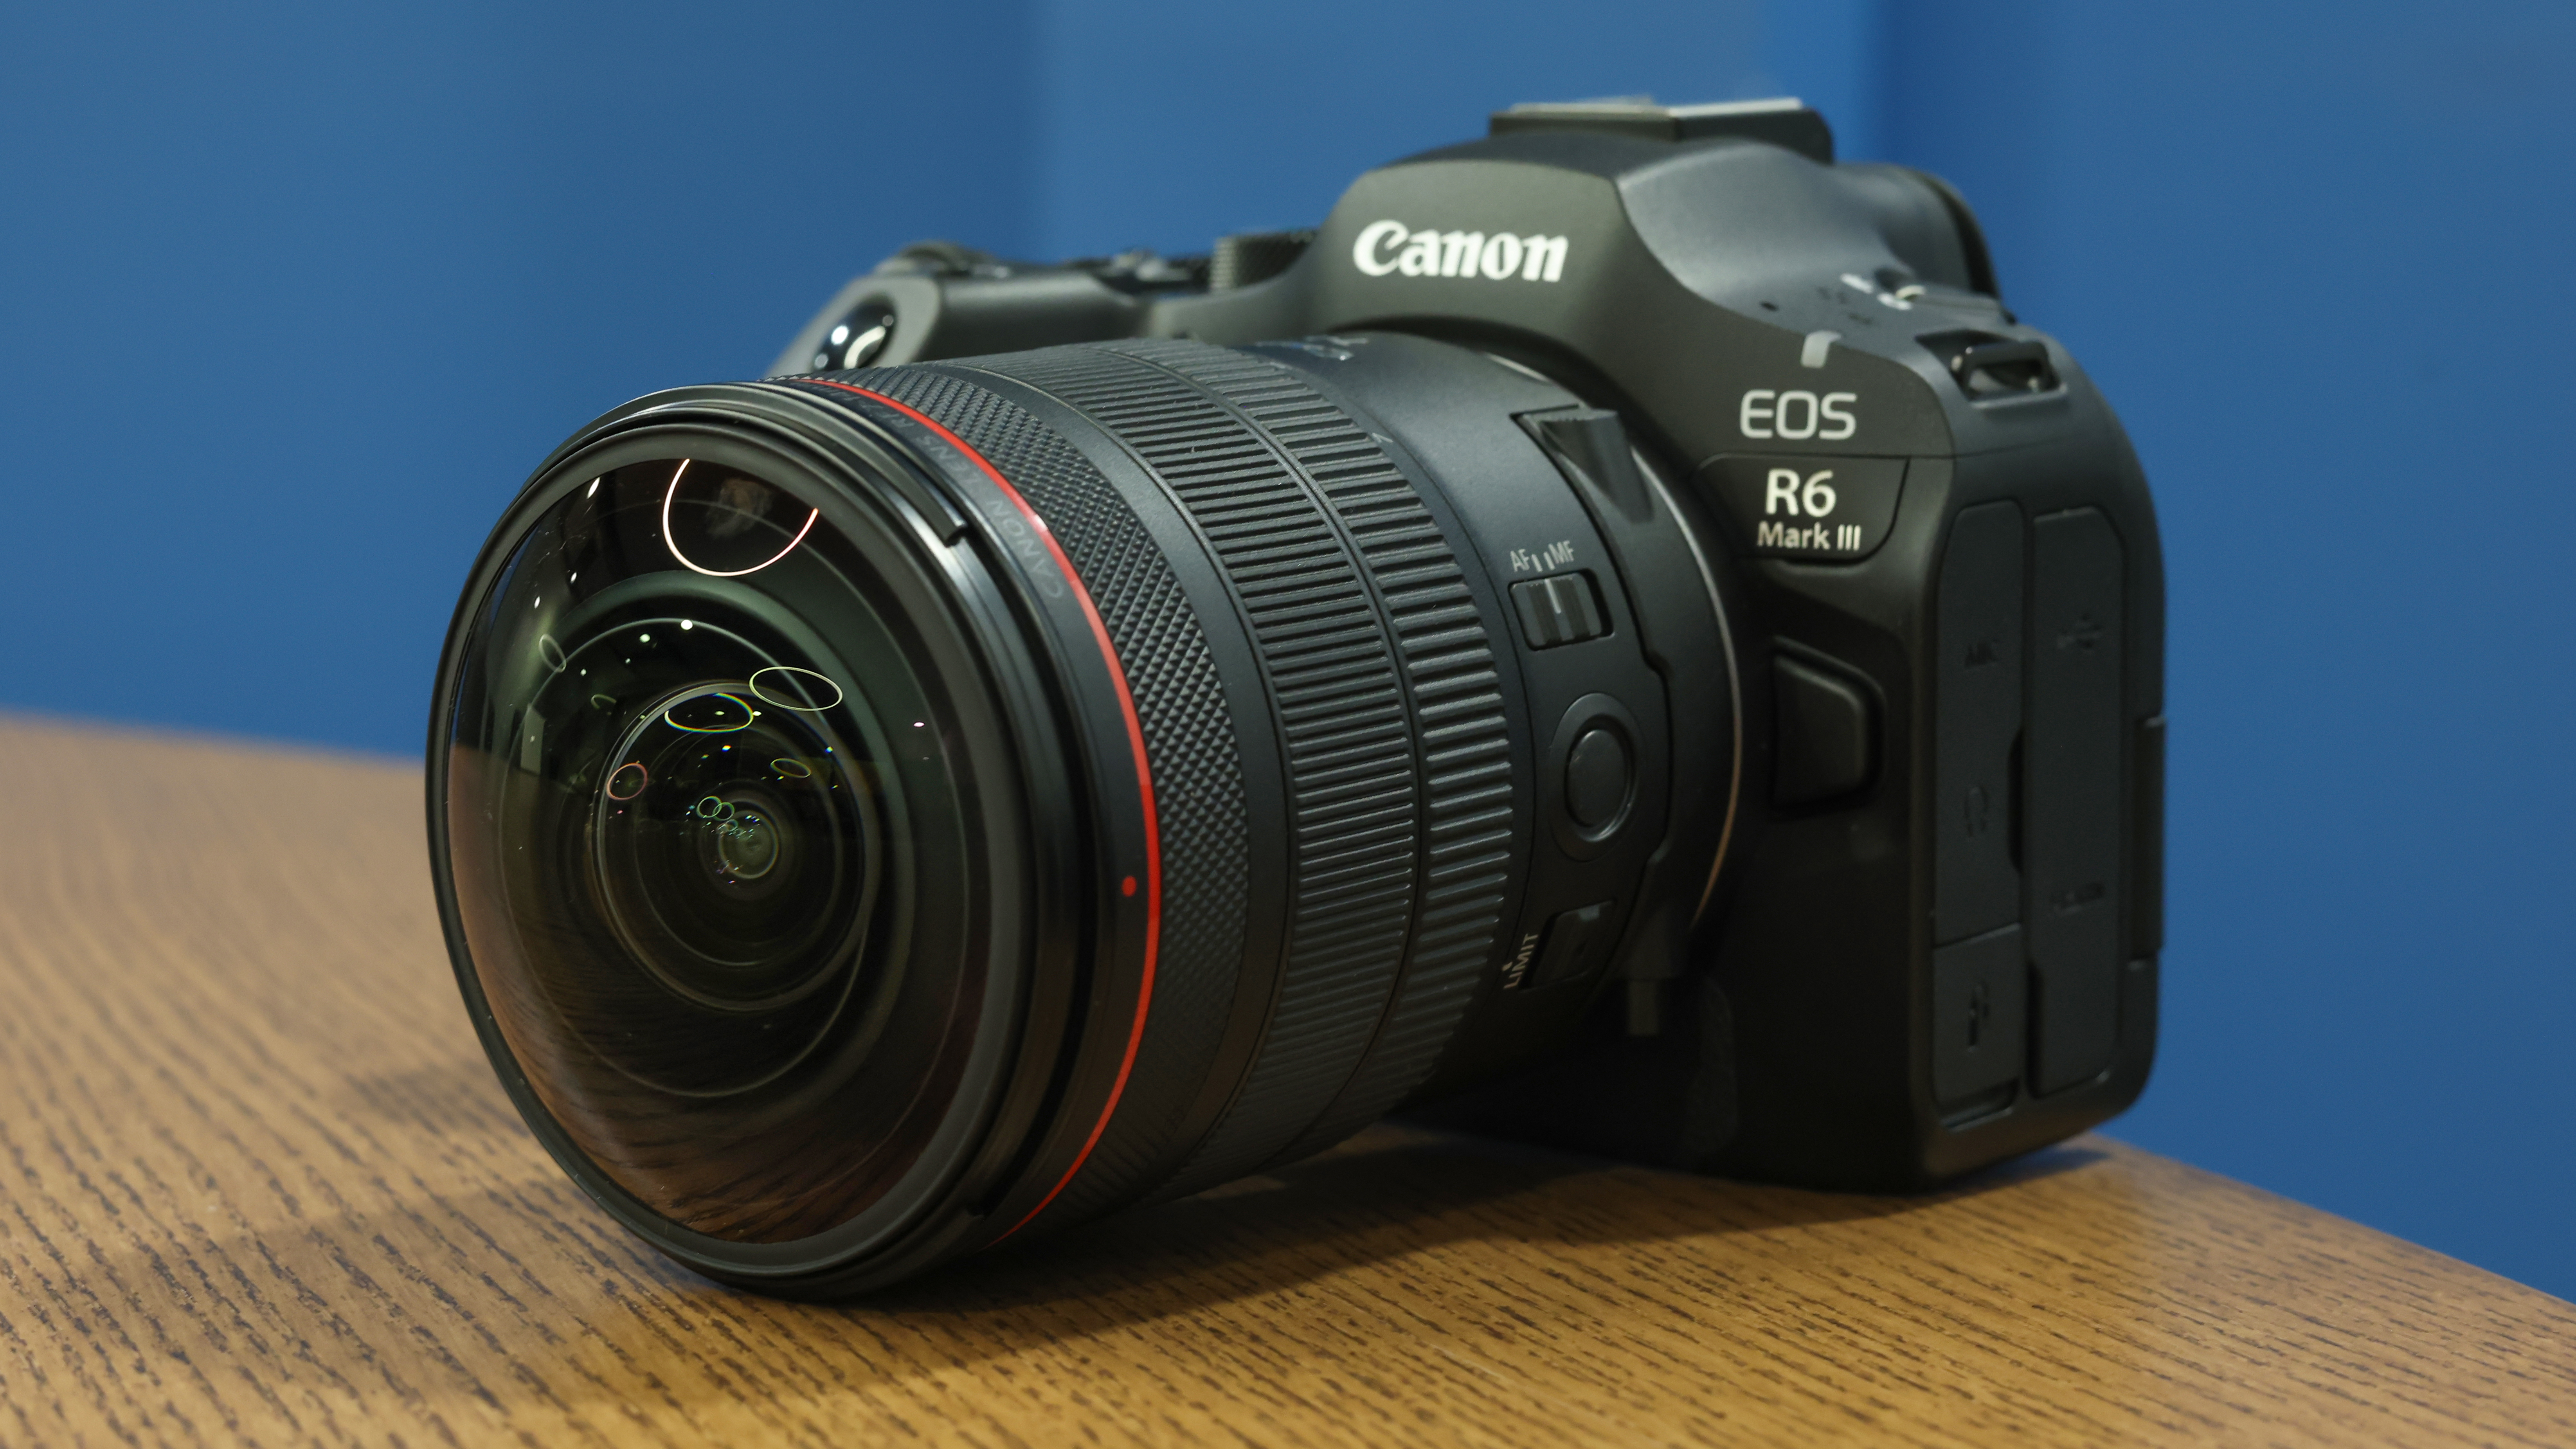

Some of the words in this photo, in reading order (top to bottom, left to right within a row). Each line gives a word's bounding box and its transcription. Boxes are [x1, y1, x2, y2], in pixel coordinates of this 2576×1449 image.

[1353, 219, 1568, 282] Canon
[1740, 389, 1857, 440] EOS
[1765, 468, 1836, 517] R6
[985, 499, 1065, 598] CANON
[1510, 548, 1530, 572] AF
[1548, 539, 1574, 564] MF
[1757, 520, 1831, 550] Mark
[1837, 524, 1861, 551] III
[1503, 933, 1539, 990] LIMIT
